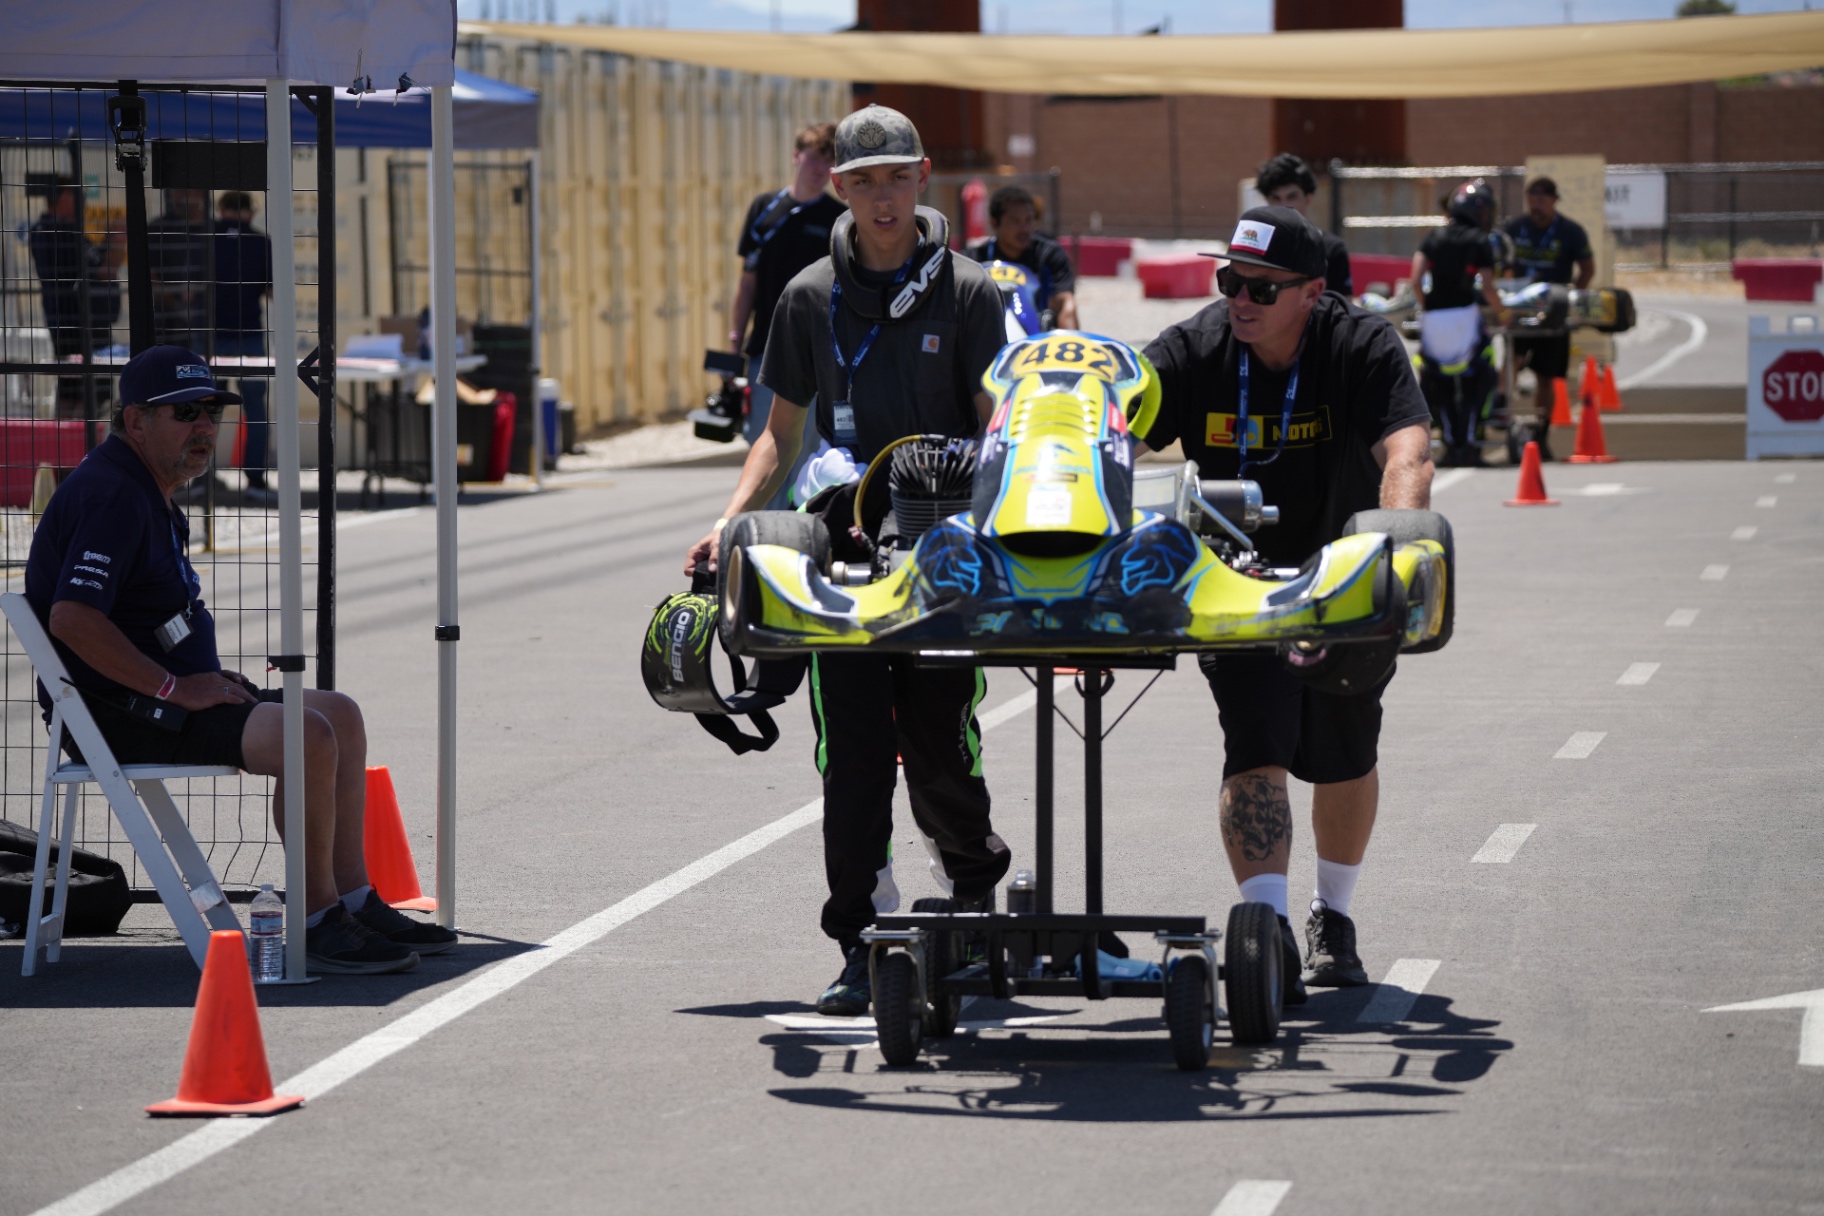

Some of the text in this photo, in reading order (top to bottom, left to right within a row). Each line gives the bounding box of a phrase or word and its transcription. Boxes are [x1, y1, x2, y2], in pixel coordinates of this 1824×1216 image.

[1022, 341, 1113, 380] 482
[1766, 372, 1824, 401] STO
[671, 611, 690, 682] BENGIO
